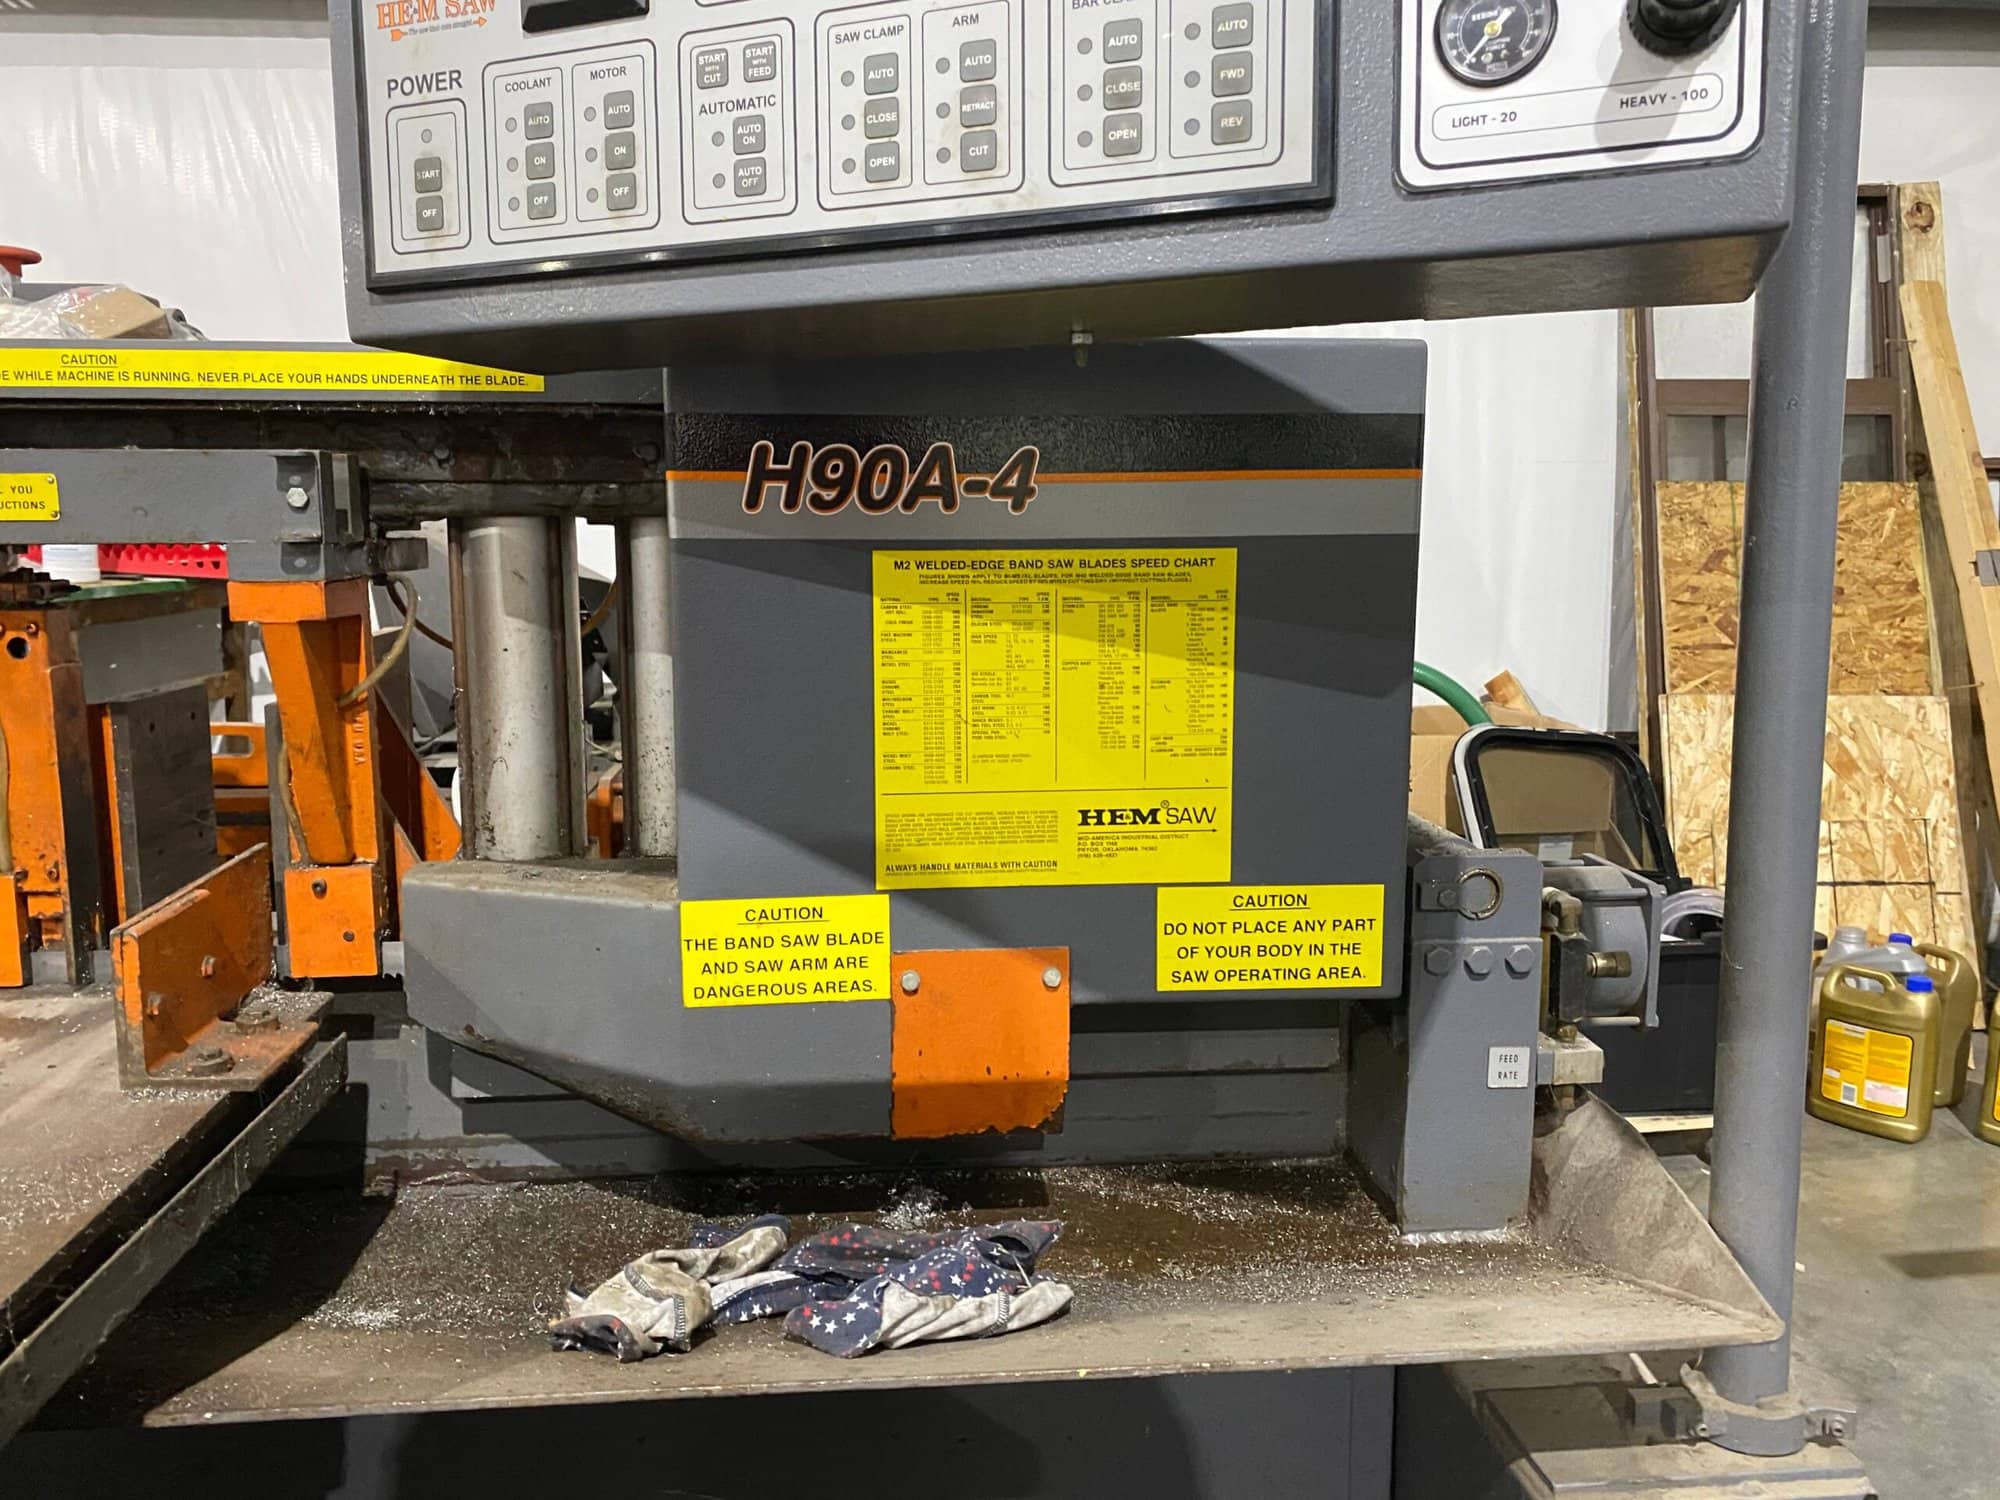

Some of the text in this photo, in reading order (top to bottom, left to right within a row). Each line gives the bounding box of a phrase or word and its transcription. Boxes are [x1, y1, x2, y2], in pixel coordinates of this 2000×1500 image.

[951, 13, 980, 28] ARM
[1217, 19, 1248, 33] AUTO
[834, 25, 905, 45] SAW CLAMP
[1108, 35, 1138, 48] AUTO
[745, 46, 774, 58] START
[698, 52, 726, 66] START
[964, 54, 992, 66] AUTO
[589, 65, 627, 81] MOTOR
[703, 73, 722, 83] CUT
[748, 66, 771, 78] FEED
[868, 67, 894, 79] AUTO
[1220, 68, 1245, 81] FWD
[387, 69, 463, 99] POWER
[504, 77, 552, 94] COOLANT
[1105, 82, 1141, 95] CLOSE
[698, 94, 777, 116] AUTOMATIC
[1619, 93, 1668, 110] HEAVY
[1681, 88, 1709, 102] 100
[608, 103, 631, 116] AUTO
[962, 101, 995, 113] RETRACT
[528, 114, 550, 126] AUTO
[866, 111, 898, 125] CLOSE
[1220, 116, 1244, 128] REV
[1451, 114, 1488, 129] LIGHT
[1500, 111, 1517, 124] 20
[737, 123, 762, 135] AUTO
[1108, 129, 1137, 141] OPEN
[743, 135, 756, 146] ON
[614, 146, 626, 156] ON
[968, 145, 989, 157] CUT
[534, 155, 546, 166] ON
[869, 156, 895, 168] OPEN
[416, 168, 440, 181] START
[738, 165, 762, 177] AUTO
[742, 177, 758, 188] OFF
[613, 186, 629, 197] OFF
[533, 195, 549, 206] OFF
[422, 208, 437, 219] OFF
[61, 354, 118, 365] CAUTION
[14, 370, 52, 381] WHILE
[57, 371, 114, 382] MACHINE
[118, 371, 129, 382] IS
[134, 371, 194, 382] RUNNING.
[198, 372, 239, 383] NEVER
[244, 372, 283, 383] PLACE
[288, 373, 321, 384] YOUR
[326, 373, 368, 384] HANDS
[372, 374, 455, 386] UNDERNEATH
[458, 375, 481, 386] THE
[485, 375, 529, 386] BLADE.
[742, 440, 1039, 515] H90A-4
[10, 485, 33, 494] YOU
[894, 557, 1216, 570] M2 WELDED-EDGE BAND SAW BLADES SPEED CHART
[1166, 807, 1217, 824] SAW
[885, 860, 1057, 872] ALWAYS HANDLE MATERIALS WITH CAUTION
[1232, 894, 1308, 908] CAUTION
[745, 906, 823, 922] CAUTION
[1164, 918, 1376, 935] DO NOT PLACE ANY PART
[684, 932, 884, 951] THE BAND SAW BLADE
[1177, 942, 1361, 959] OF YOUR BODY IN THE
[701, 956, 869, 975] AND SAW ARM ARE
[1171, 966, 1366, 983] SAW OPERATING AREA.
[693, 980, 877, 999] DANGEROUS AREAS.
[1498, 1054, 1519, 1063] FEED
[1497, 1071, 1519, 1080] RATE
